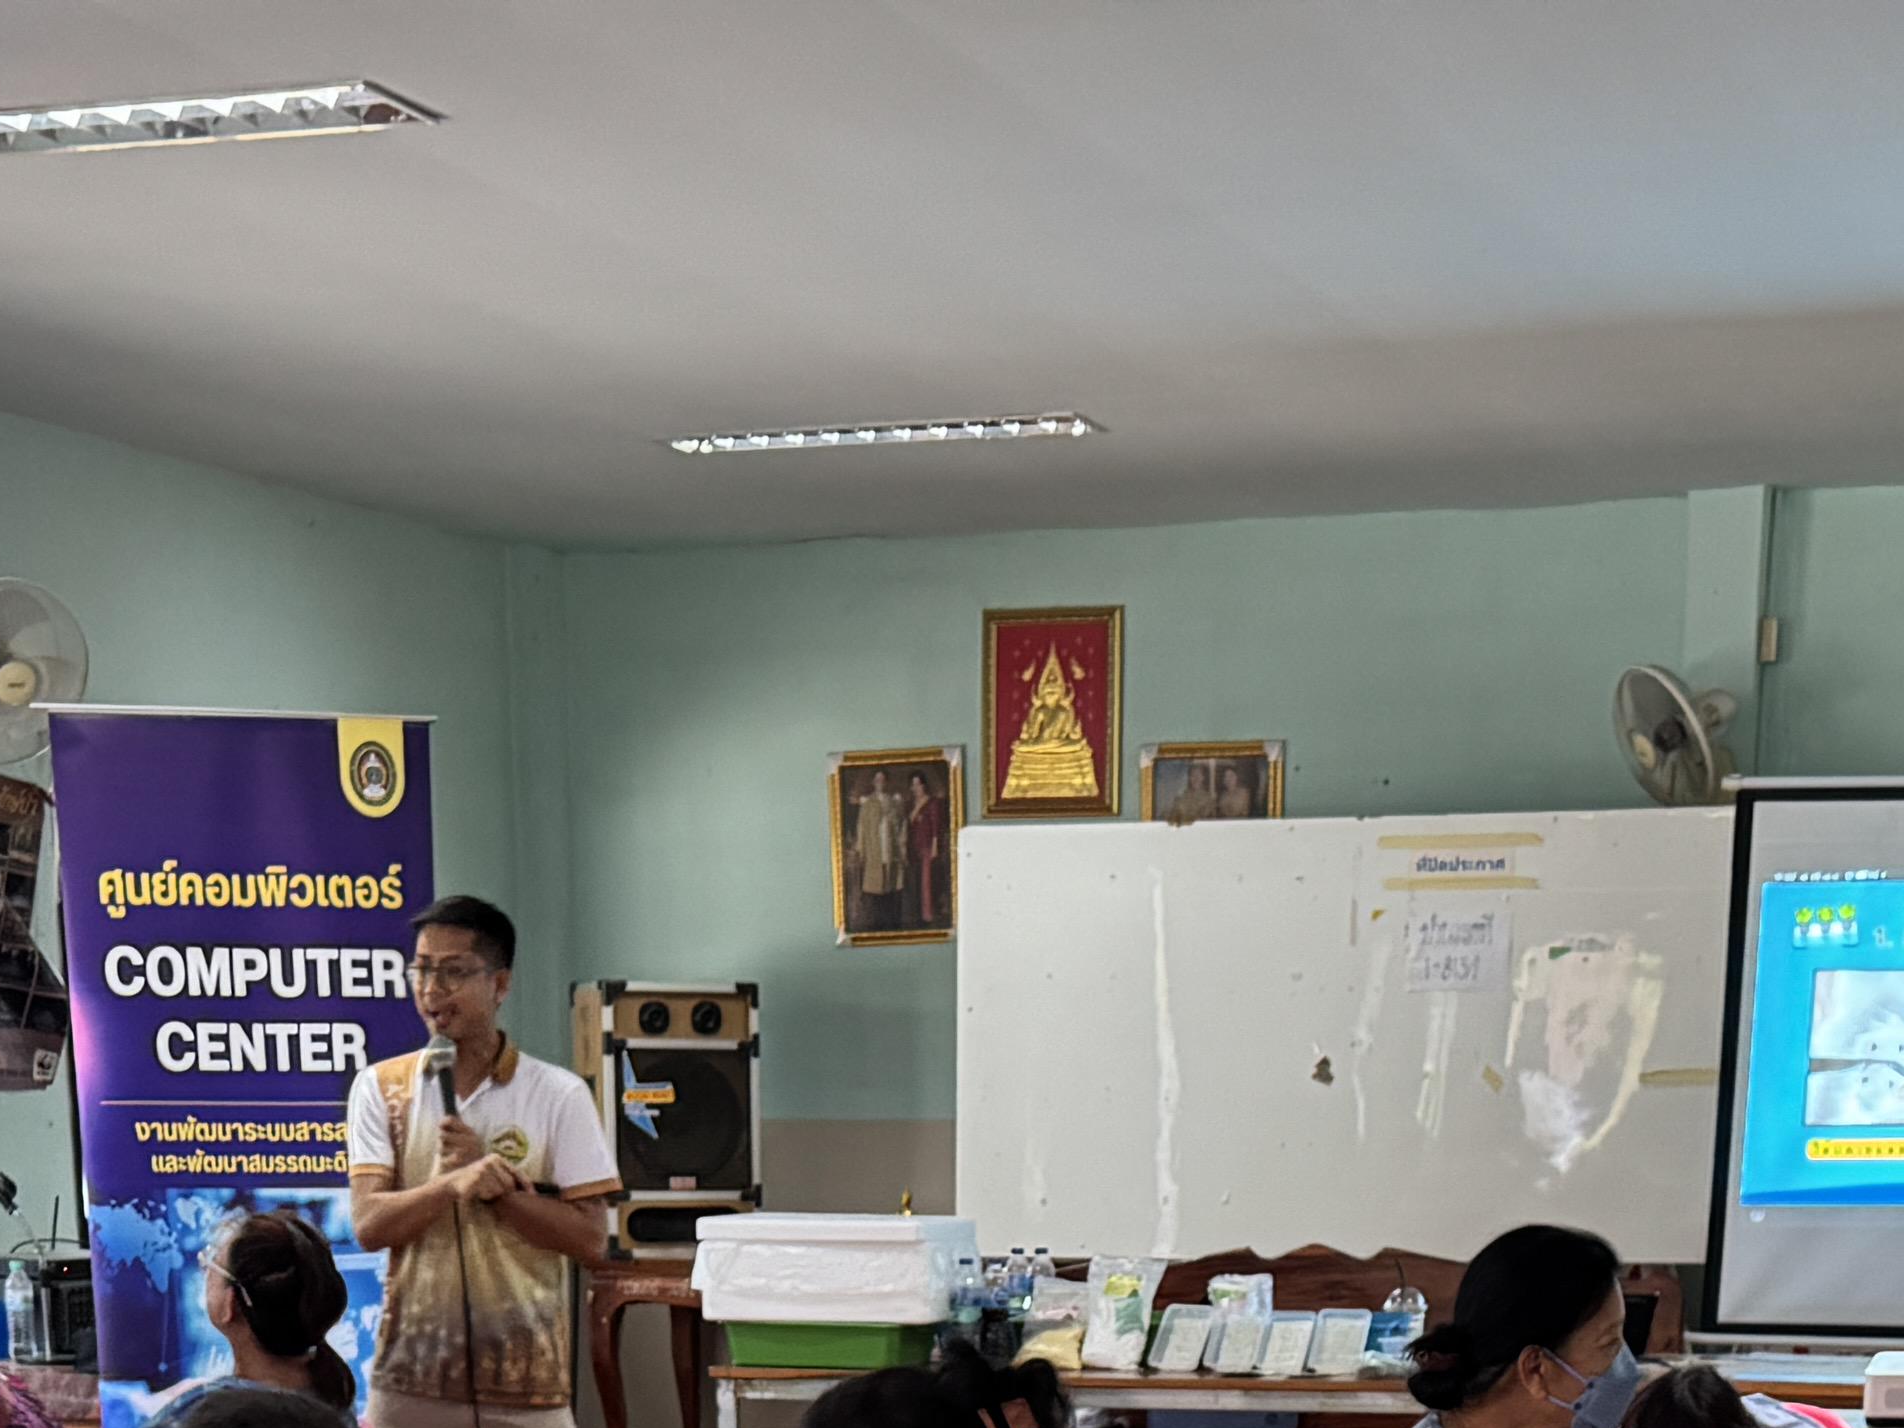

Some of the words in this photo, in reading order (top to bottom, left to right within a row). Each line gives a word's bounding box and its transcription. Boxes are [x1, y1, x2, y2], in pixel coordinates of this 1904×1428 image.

[98, 859, 403, 919] ศูนย์คอมพิวเตอร์
[104, 944, 407, 999] COMPUTER
[156, 1021, 368, 1073] CENTER
[135, 1115, 347, 1142] งานพัฒนาระบบสารส
[151, 1149, 347, 1174] และพัฒนาสมรรถนะดิ
